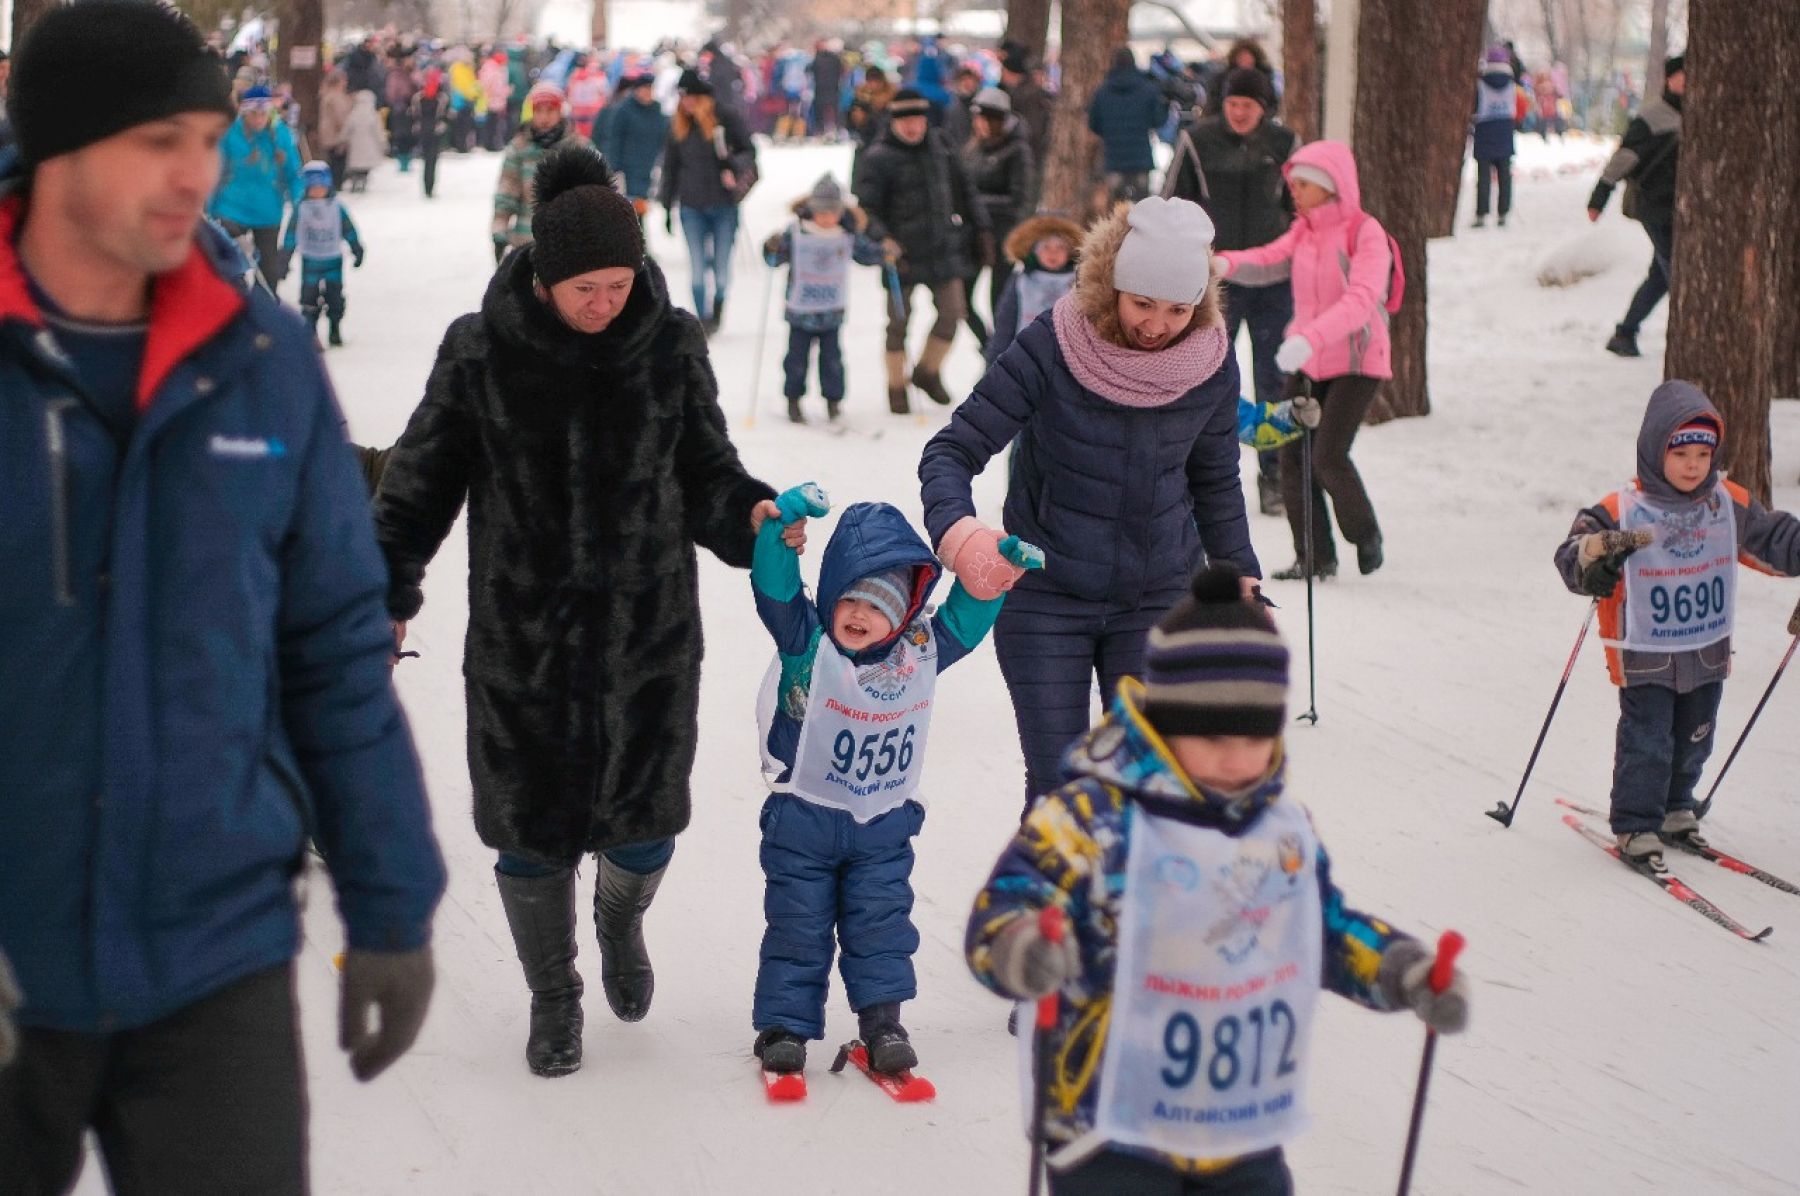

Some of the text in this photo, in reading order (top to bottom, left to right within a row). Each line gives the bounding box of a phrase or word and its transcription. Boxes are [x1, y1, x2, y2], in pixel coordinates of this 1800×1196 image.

[1650, 575, 1725, 624] 9690
[825, 698, 869, 722] ЛЫЖНЯ
[830, 723, 915, 782] 9556
[1160, 999, 1297, 1091] 9812
